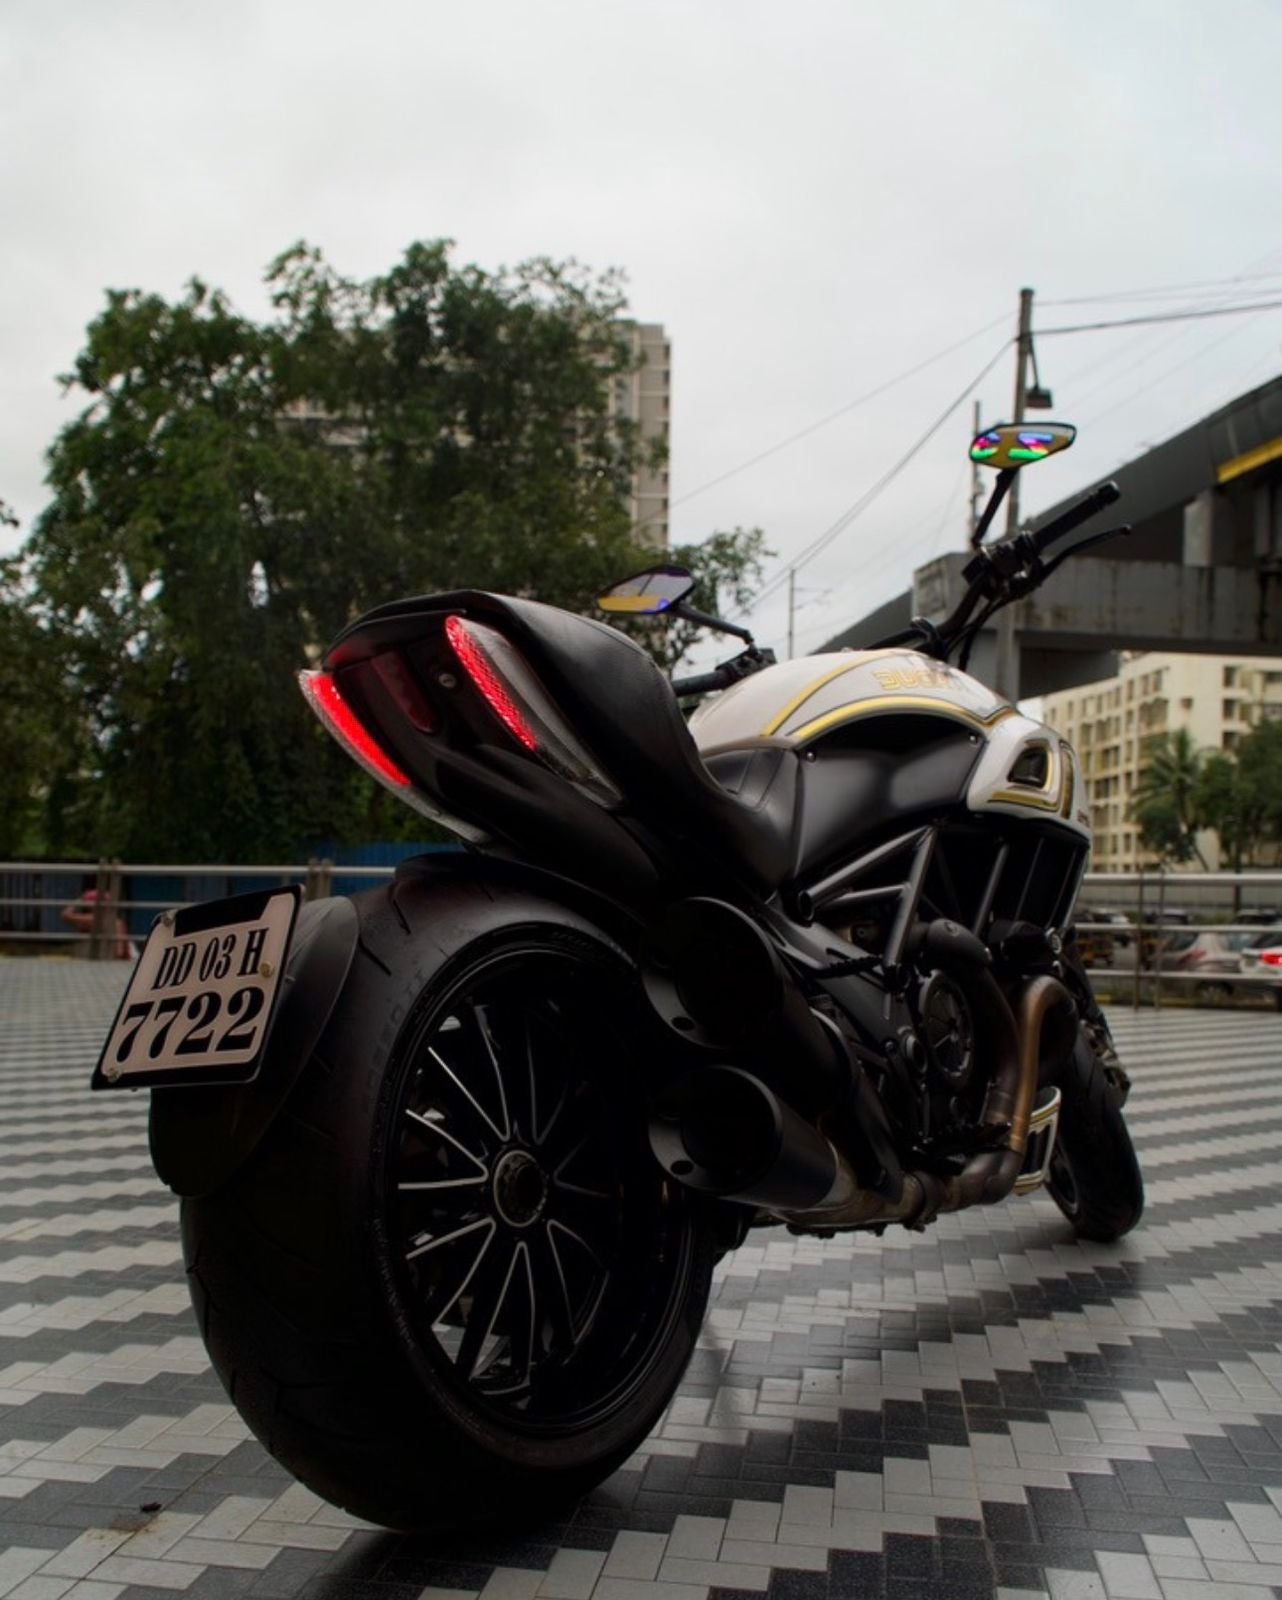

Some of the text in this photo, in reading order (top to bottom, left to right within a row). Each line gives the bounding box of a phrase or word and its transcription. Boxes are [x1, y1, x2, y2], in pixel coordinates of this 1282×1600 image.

[151, 928, 269, 990] DD 03 H
[116, 986, 264, 1062] 7722
